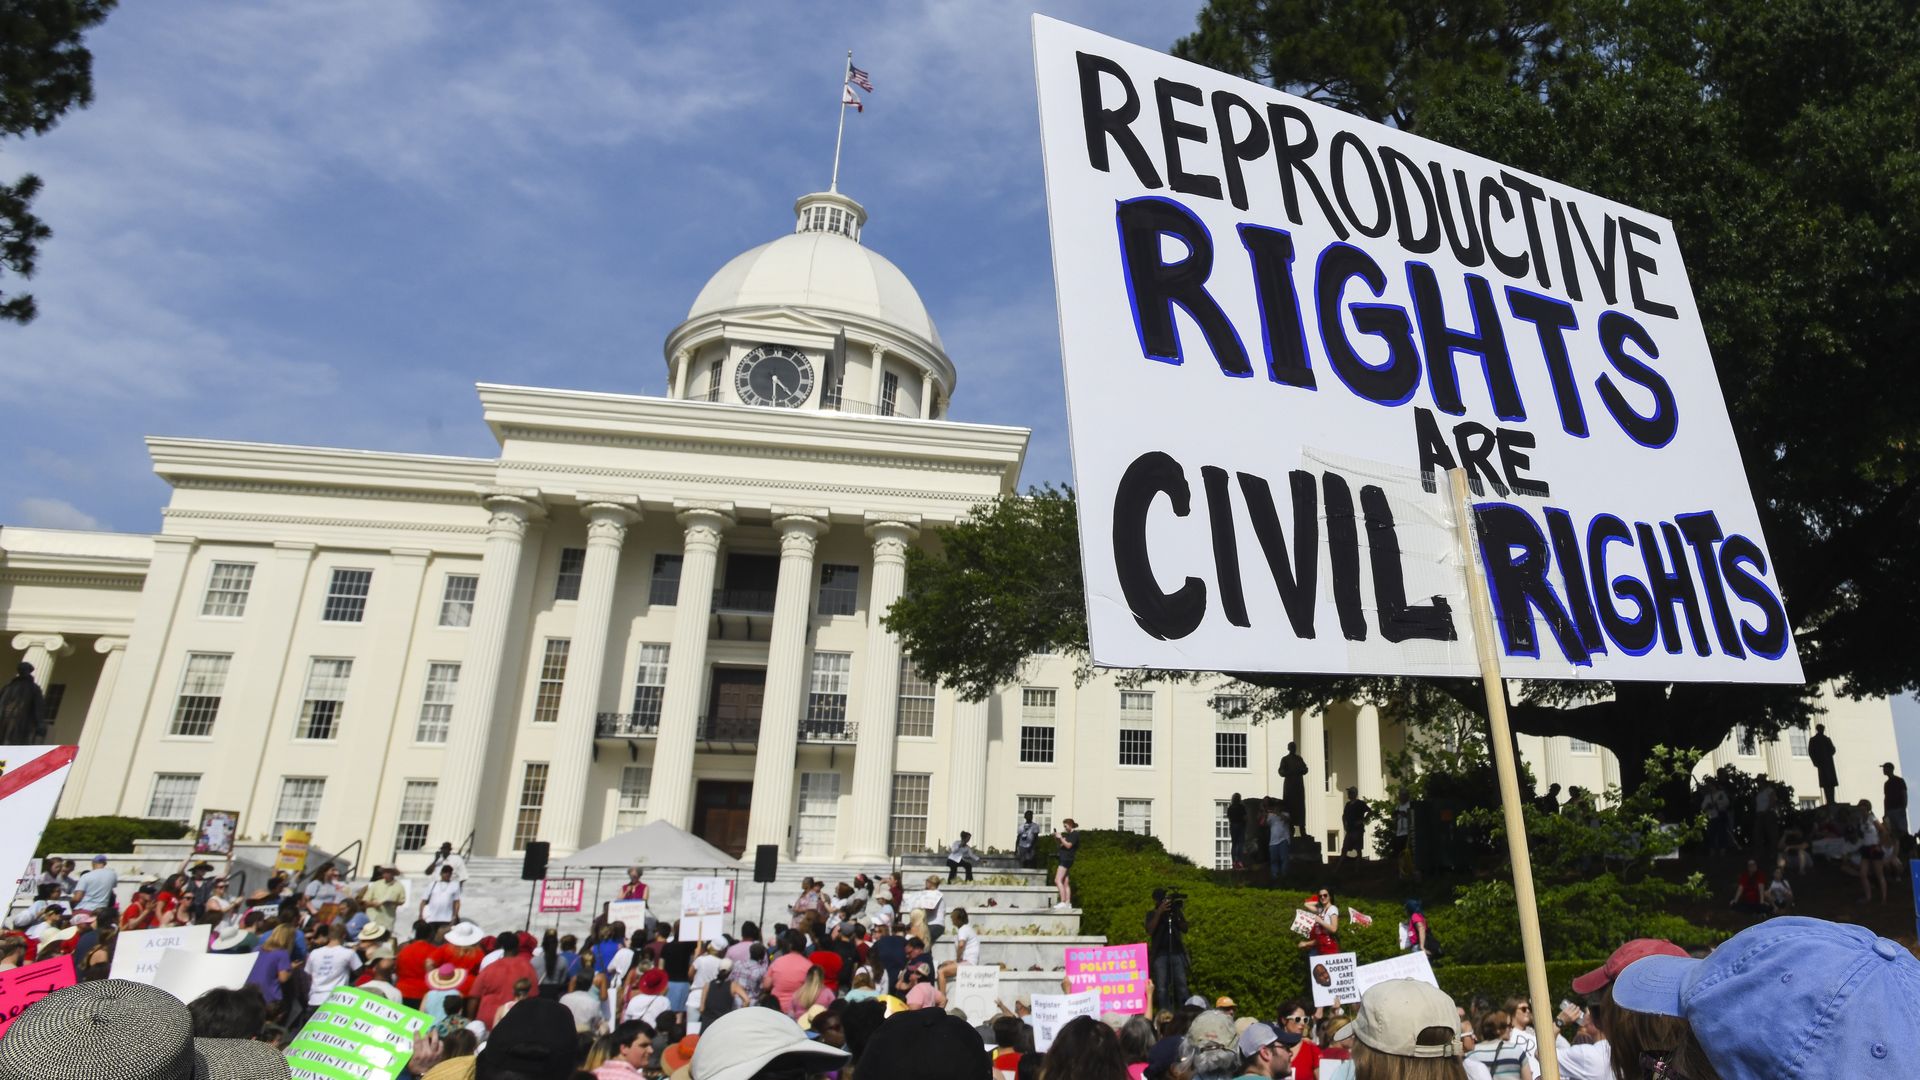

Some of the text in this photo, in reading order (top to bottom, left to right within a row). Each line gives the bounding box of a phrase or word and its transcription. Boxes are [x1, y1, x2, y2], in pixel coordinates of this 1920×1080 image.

[1077, 51, 1678, 319] REPRODUCTIVE
[1115, 195, 1680, 449] RIGHTS
[1414, 406, 1551, 498] ARE
[1112, 451, 1789, 666] CIVIL RIGHTS
[145, 937, 181, 948] A GIRL
[1107, 949, 1136, 960] PLAY
[1079, 960, 1137, 972] POLITICS
[1325, 957, 1352, 965] ALABAMA
[1329, 964, 1353, 973] DOESN'T
[1068, 973, 1096, 984] WITH
[1338, 971, 1354, 979] CARE
[1328, 985, 1356, 994] WOMEN'S
[1034, 1000, 1061, 1009] Register
[333, 1014, 349, 1026] TO
[353, 1021, 373, 1034] SIT
[311, 1033, 356, 1050] SERIOUS
